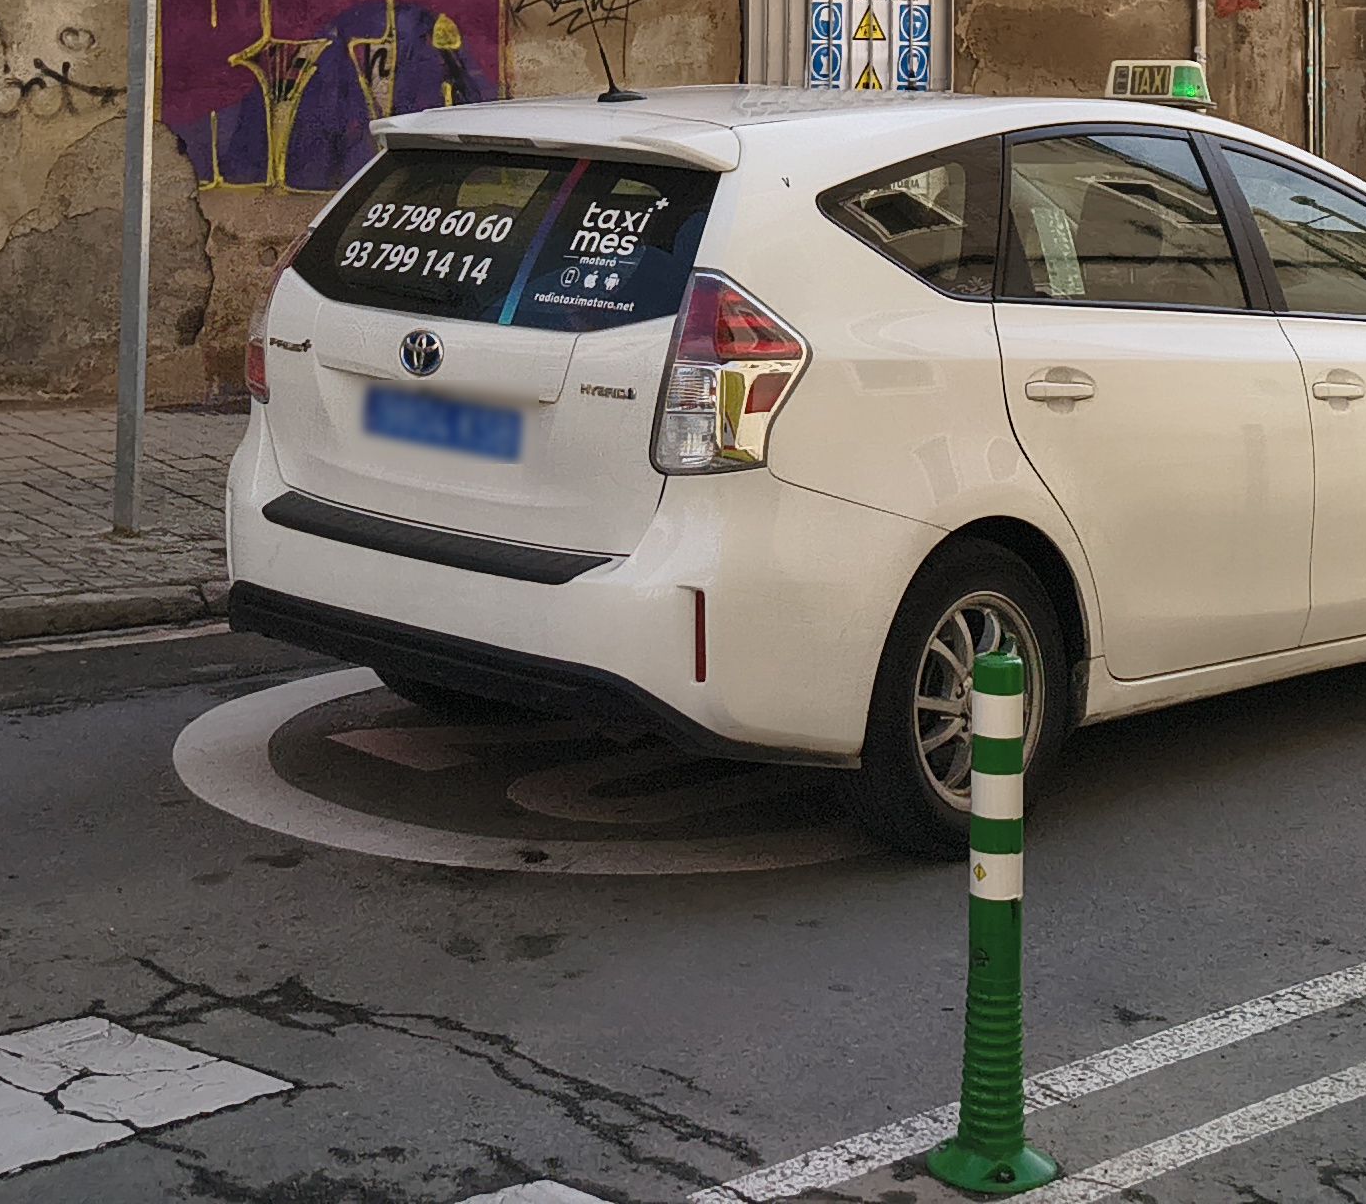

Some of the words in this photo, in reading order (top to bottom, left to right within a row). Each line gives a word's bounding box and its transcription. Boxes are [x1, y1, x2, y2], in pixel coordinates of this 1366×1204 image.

[1133, 66, 1171, 94] TAXI
[361, 203, 391, 229] 93
[392, 205, 441, 234] 798
[439, 210, 476, 238] 60
[475, 215, 513, 244] 60
[569, 227, 639, 256] més
[340, 240, 374, 268] 93
[371, 242, 420, 274] 799
[422, 249, 454, 280] 14
[457, 254, 493, 286] 14
[579, 256, 617, 267] mataró
[534, 292, 635, 312] radiotaximataro.net
